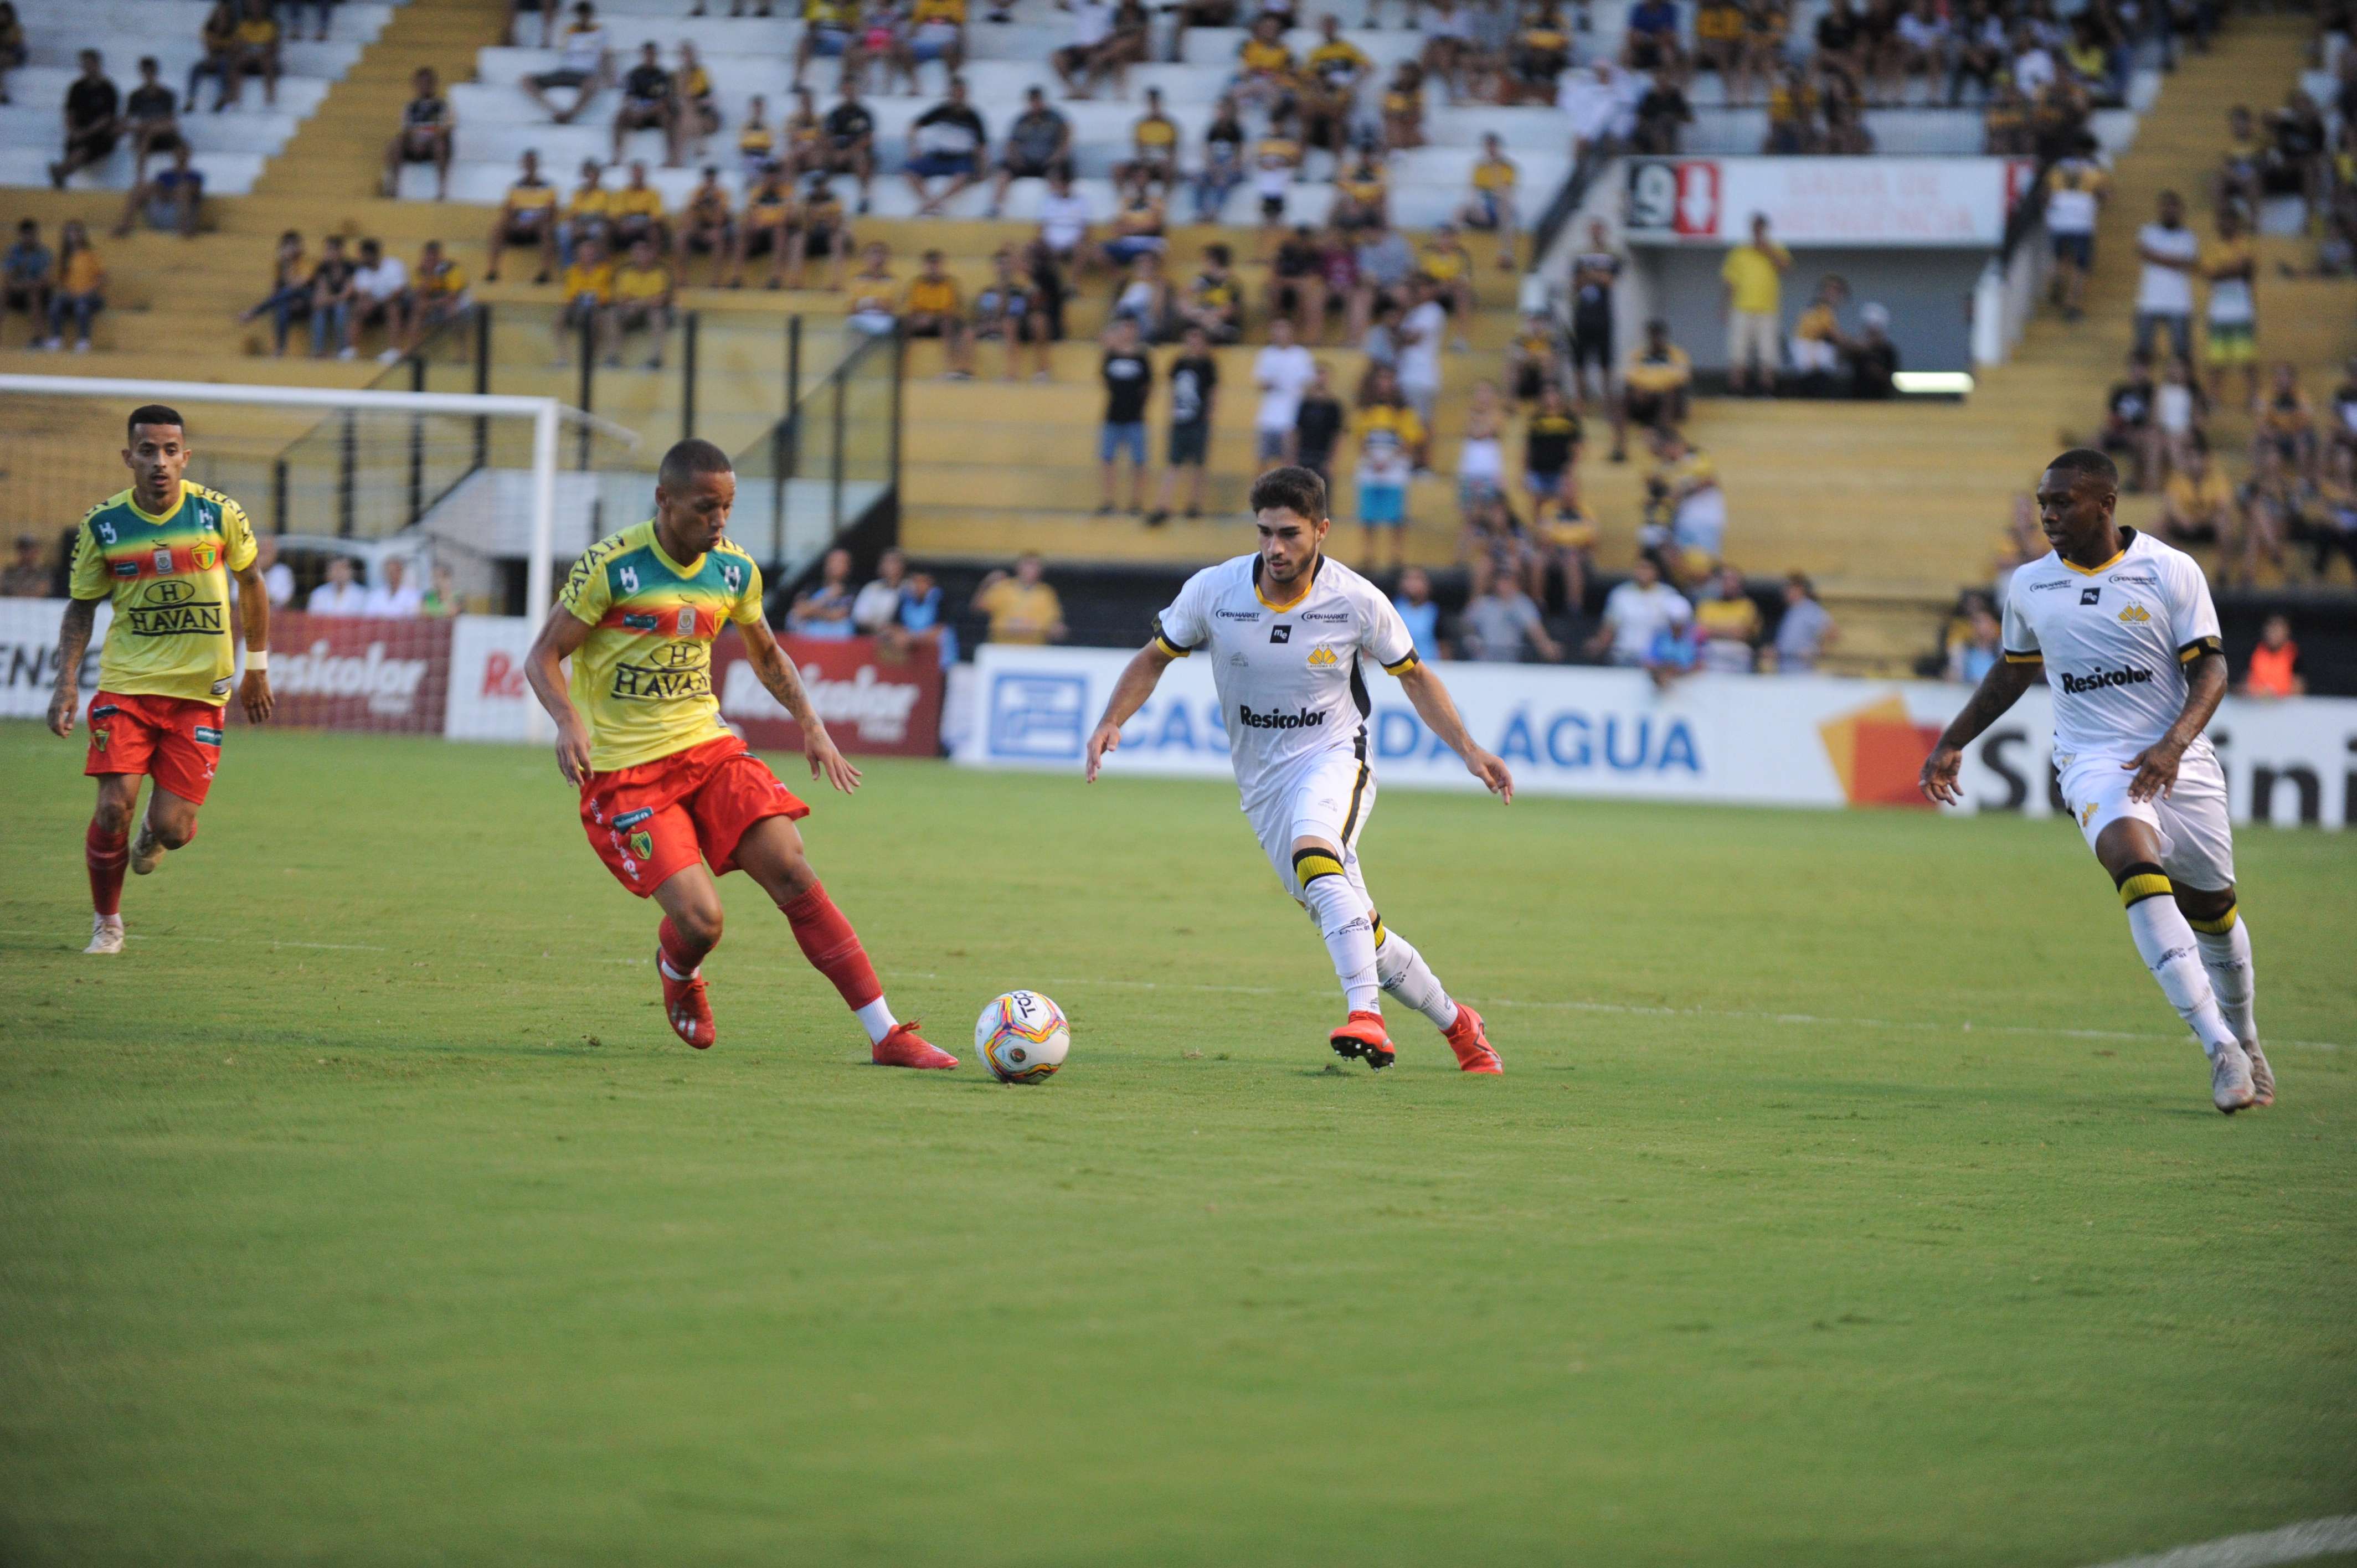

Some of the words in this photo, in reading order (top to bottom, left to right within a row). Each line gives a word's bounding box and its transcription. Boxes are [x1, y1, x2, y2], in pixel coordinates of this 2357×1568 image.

[161, 584, 179, 601] H
[130, 608, 222, 630] HAVAN
[670, 646, 687, 665] H
[2061, 665, 2153, 695] Resicolor
[1241, 704, 1327, 729] Resicolor
[1496, 703, 1700, 773] ÁGUA
